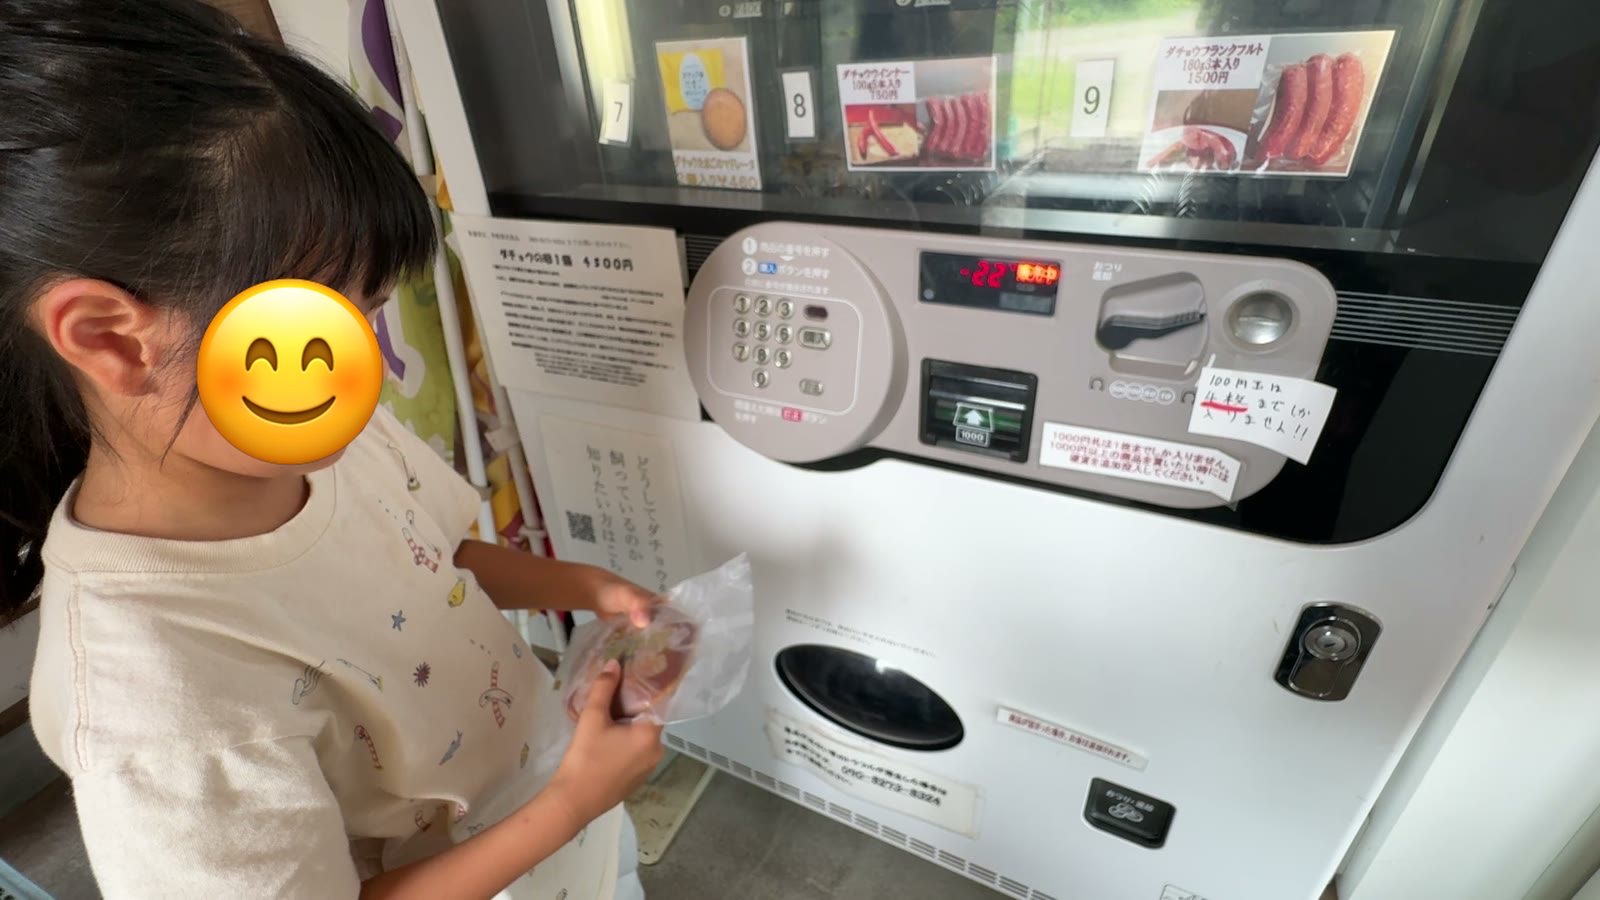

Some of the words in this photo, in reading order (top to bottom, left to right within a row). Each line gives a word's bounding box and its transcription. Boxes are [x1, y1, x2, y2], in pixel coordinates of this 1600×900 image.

[1165, 43, 1264, 59] ダチョウフランクフルト
[1187, 71, 1229, 84] 1500円
[794, 93, 806, 118] 8
[1083, 86, 1101, 115] 9
[614, 101, 623, 123] 7
[1210, 374, 1282, 392] 100円玉は
[961, 430, 983, 442] 1000
